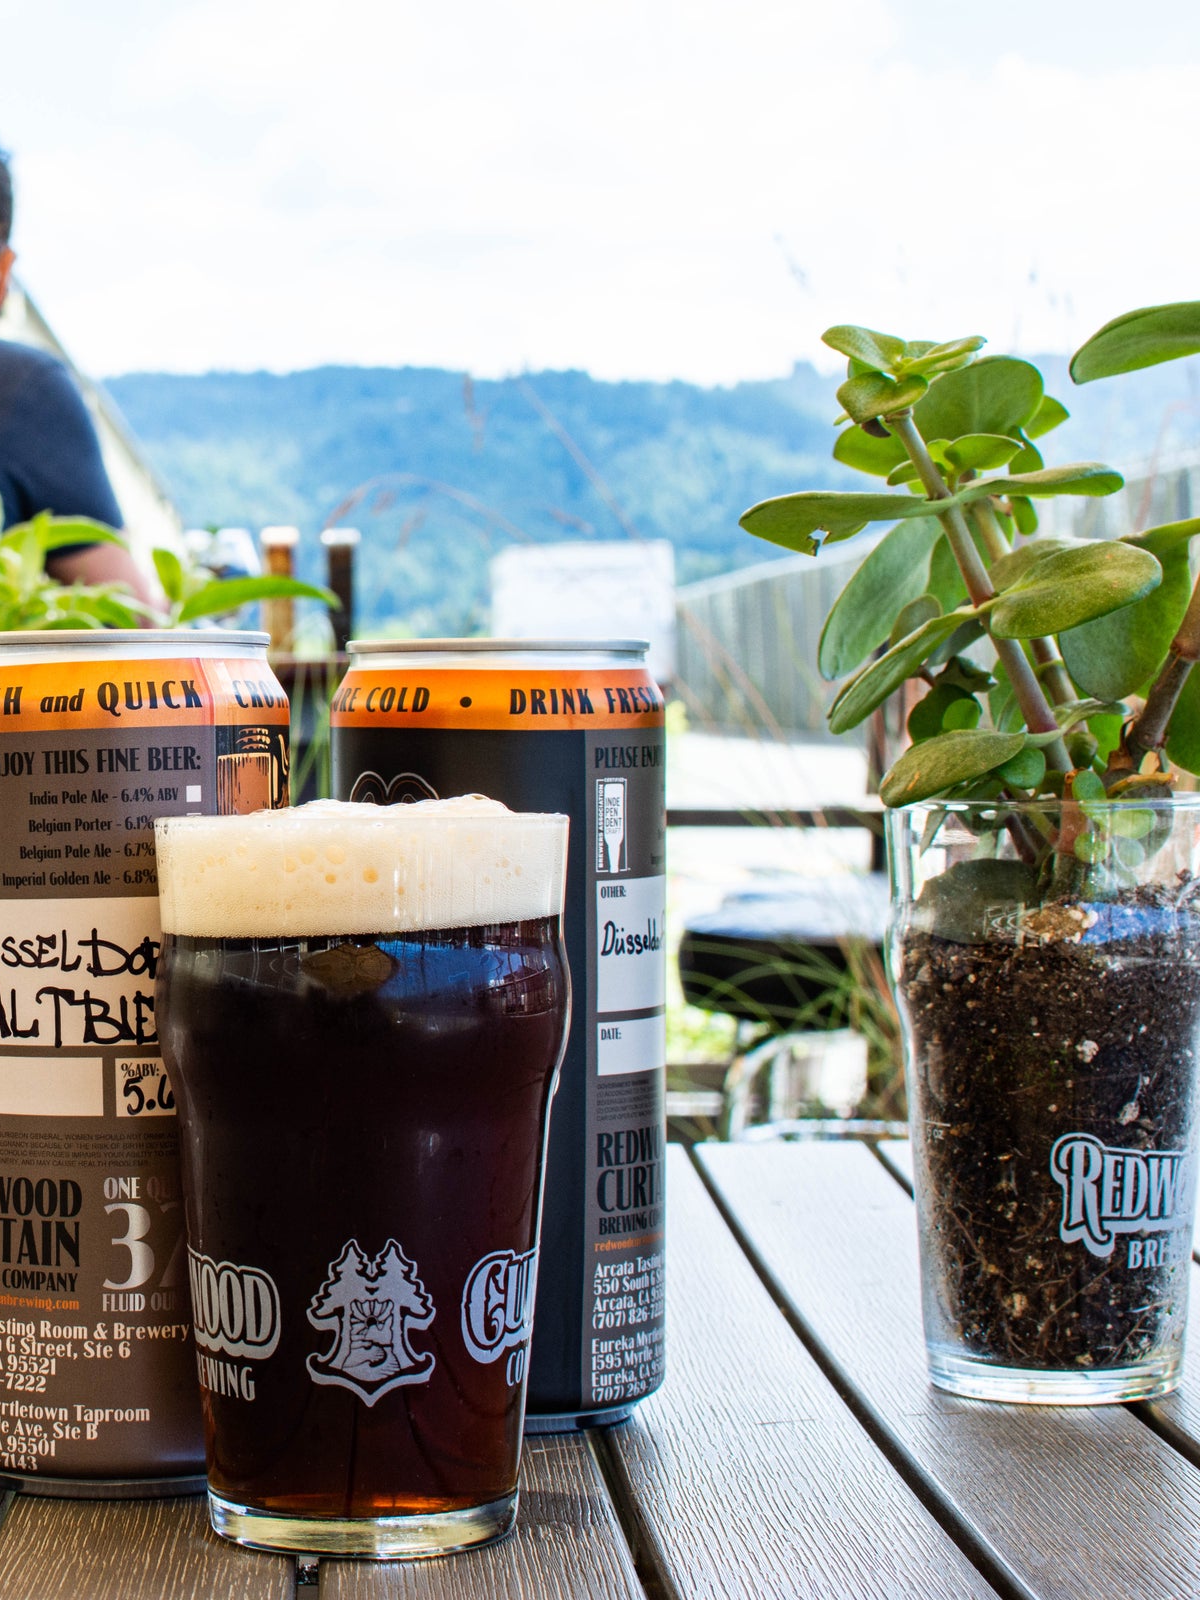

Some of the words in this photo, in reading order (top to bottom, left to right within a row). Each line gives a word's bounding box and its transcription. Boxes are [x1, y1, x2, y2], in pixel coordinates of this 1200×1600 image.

[40, 688, 85, 713] and
[97, 680, 203, 717] QUICK
[366, 686, 430, 713] COLD
[509, 688, 595, 715] DRINK
[42, 749, 89, 775] THIS
[97, 747, 140, 773] FINE
[148, 745, 201, 771] BEER:
[595, 746, 638, 768] PLEASE
[29, 790, 58, 806] India
[62, 790, 87, 805] Pale
[92, 789, 108, 804] Ale
[121, 787, 154, 803] 6.4%
[157, 787, 179, 801] ABV
[606, 797, 620, 807] INDE
[606, 808, 618, 817] PEN
[606, 818, 622, 828] DENT
[28, 817, 71, 836] Belgian
[75, 816, 112, 832] Porter
[125, 815, 156, 831] 6.1%
[20, 845, 61, 862] Belgian
[65, 844, 90, 859] Pale
[94, 843, 111, 858] Ale
[125, 842, 156, 858] 6.7%
[2, 871, 46, 889] Imperial
[50, 871, 89, 886] Golden
[93, 870, 111, 885] Ale
[123, 868, 156, 885] 6.8%
[601, 885, 626, 899] OTHER:
[601, 1028, 622, 1041] DATE:
[103, 1176, 141, 1200] ONE
[599, 1213, 647, 1235] BREWING
[2, 1267, 78, 1292] COMPANY
[594, 1260, 634, 1279] Arcata
[593, 1277, 620, 1296] 550
[622, 1272, 650, 1292] South
[103, 1293, 145, 1312] FLUID
[150, 1292, 175, 1311] OU
[593, 1295, 636, 1314] Arcata,
[638, 1289, 650, 1306] CA
[40, 1320, 88, 1339] Room
[93, 1323, 108, 1340] &
[113, 1323, 190, 1341] Brewery
[592, 1312, 626, 1330] (707)
[6, 1335, 16, 1354] G
[20, 1337, 78, 1360] Street,
[83, 1340, 115, 1358] Ste
[118, 1341, 131, 1358] 6
[591, 1334, 634, 1354] Eureka
[7, 1354, 56, 1375] 95521
[591, 1353, 622, 1372] 1595
[591, 1368, 637, 1388] Eureka,
[639, 1363, 650, 1380] CA
[591, 1384, 625, 1403] (707)
[73, 1404, 150, 1427] Taproom
[14, 1418, 48, 1441] Ave,
[53, 1421, 81, 1440] Ste
[86, 1422, 98, 1440] B
[7, 1435, 56, 1457] 95501
